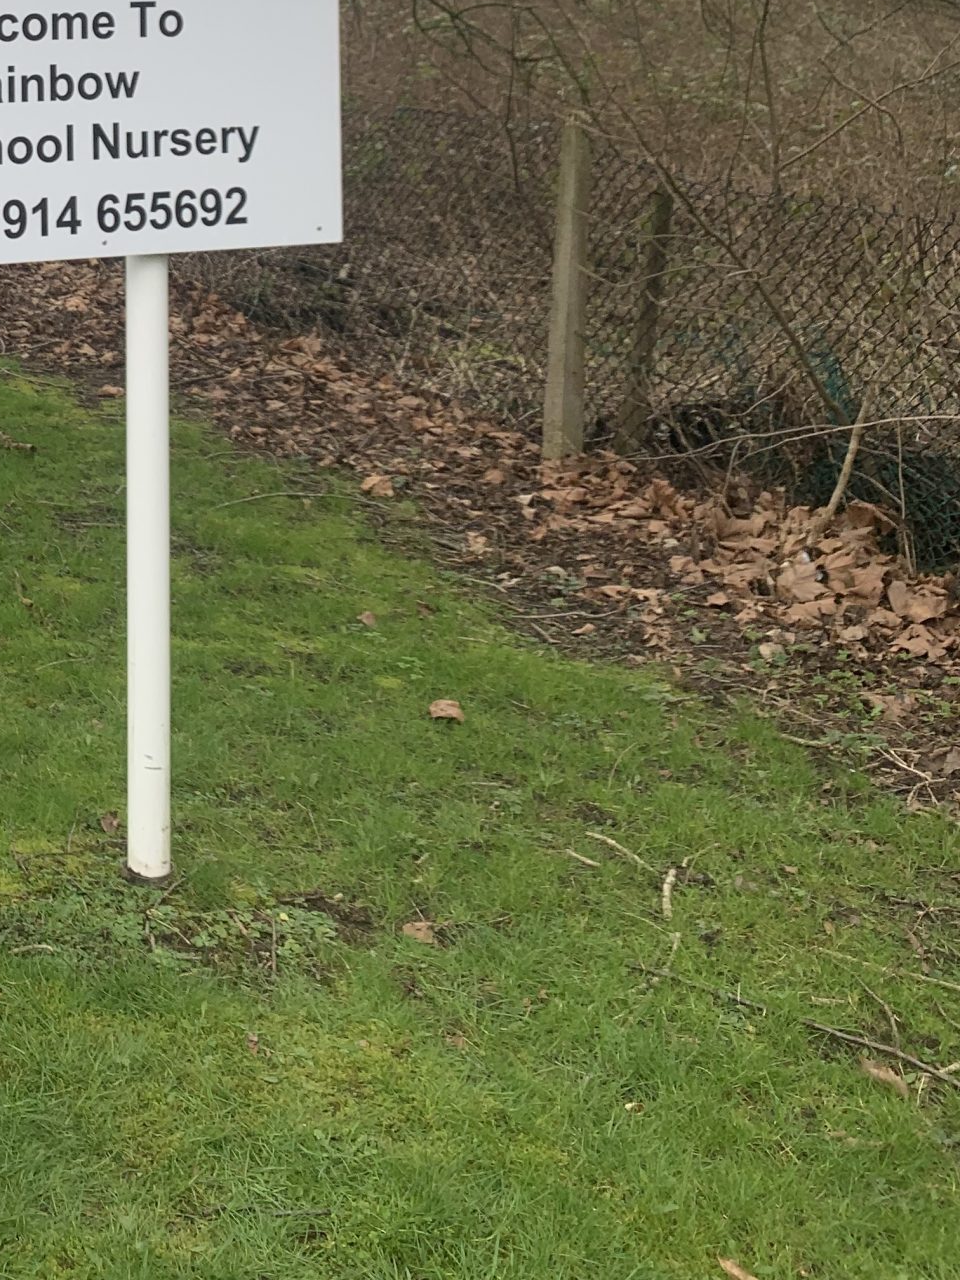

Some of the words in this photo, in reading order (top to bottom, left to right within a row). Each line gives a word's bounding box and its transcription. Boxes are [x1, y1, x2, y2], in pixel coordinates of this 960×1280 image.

[130, 1, 183, 38] To
[92, 122, 259, 163] Nursery
[97, 186, 247, 233] 655692
